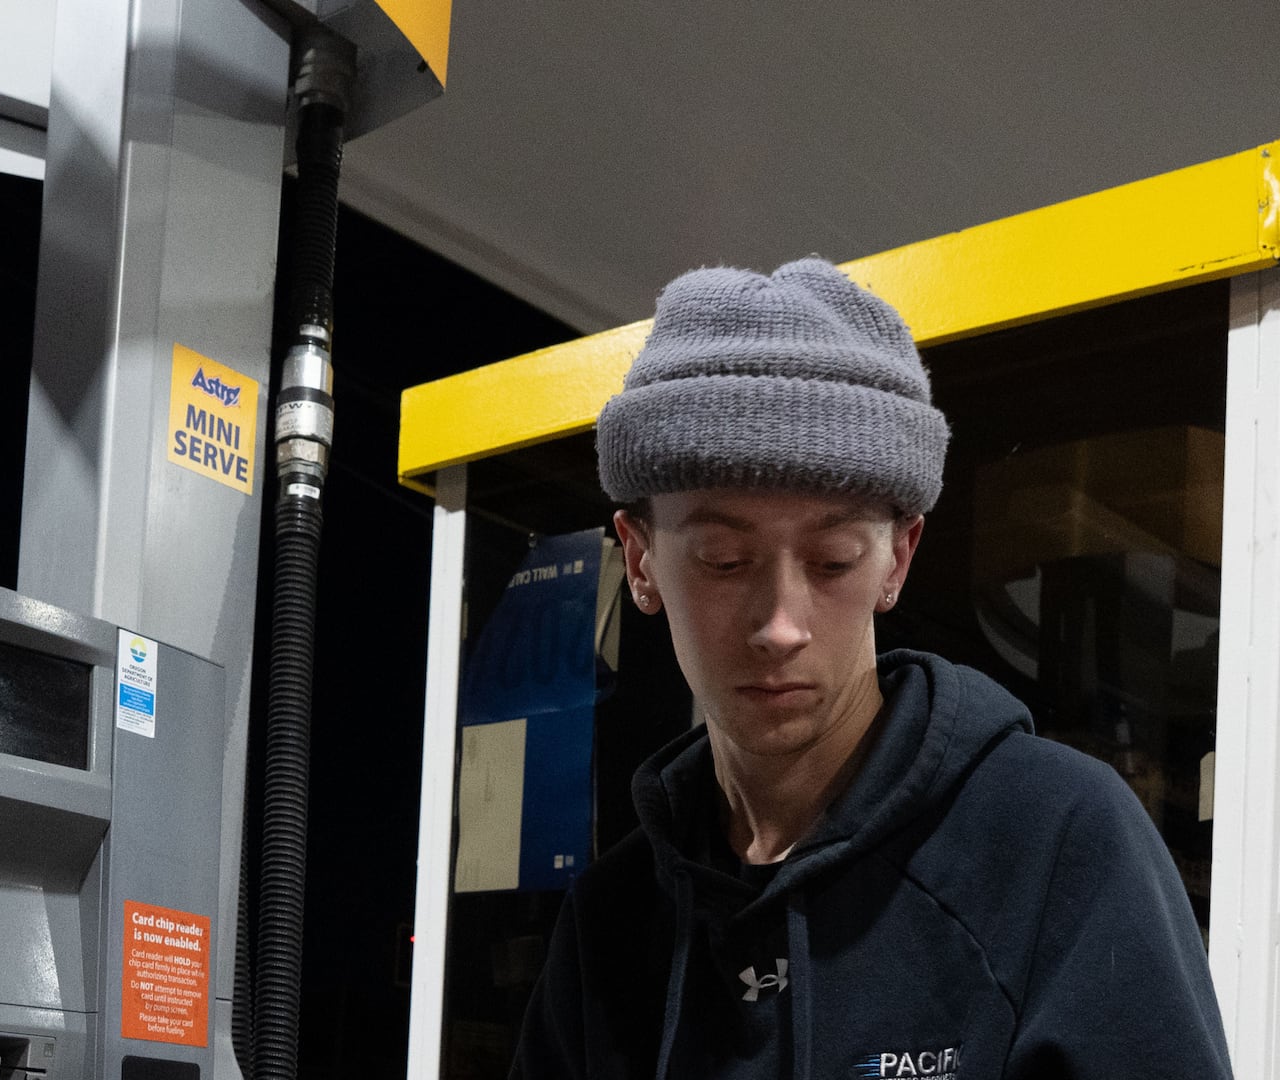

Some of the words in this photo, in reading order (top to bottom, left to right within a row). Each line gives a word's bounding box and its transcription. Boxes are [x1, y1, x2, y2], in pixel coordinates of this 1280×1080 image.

[186, 403, 240, 450] MINI
[174, 430, 248, 483] SERVE
[132, 912, 154, 927] Card
[156, 917, 175, 933] chip
[176, 923, 203, 937] reader
[134, 928, 142, 940] is
[144, 932, 163, 944] now
[164, 935, 202, 952] enabled.
[132, 948, 145, 959] Card
[174, 955, 190, 966] HOLD
[140, 982, 154, 991] NOT
